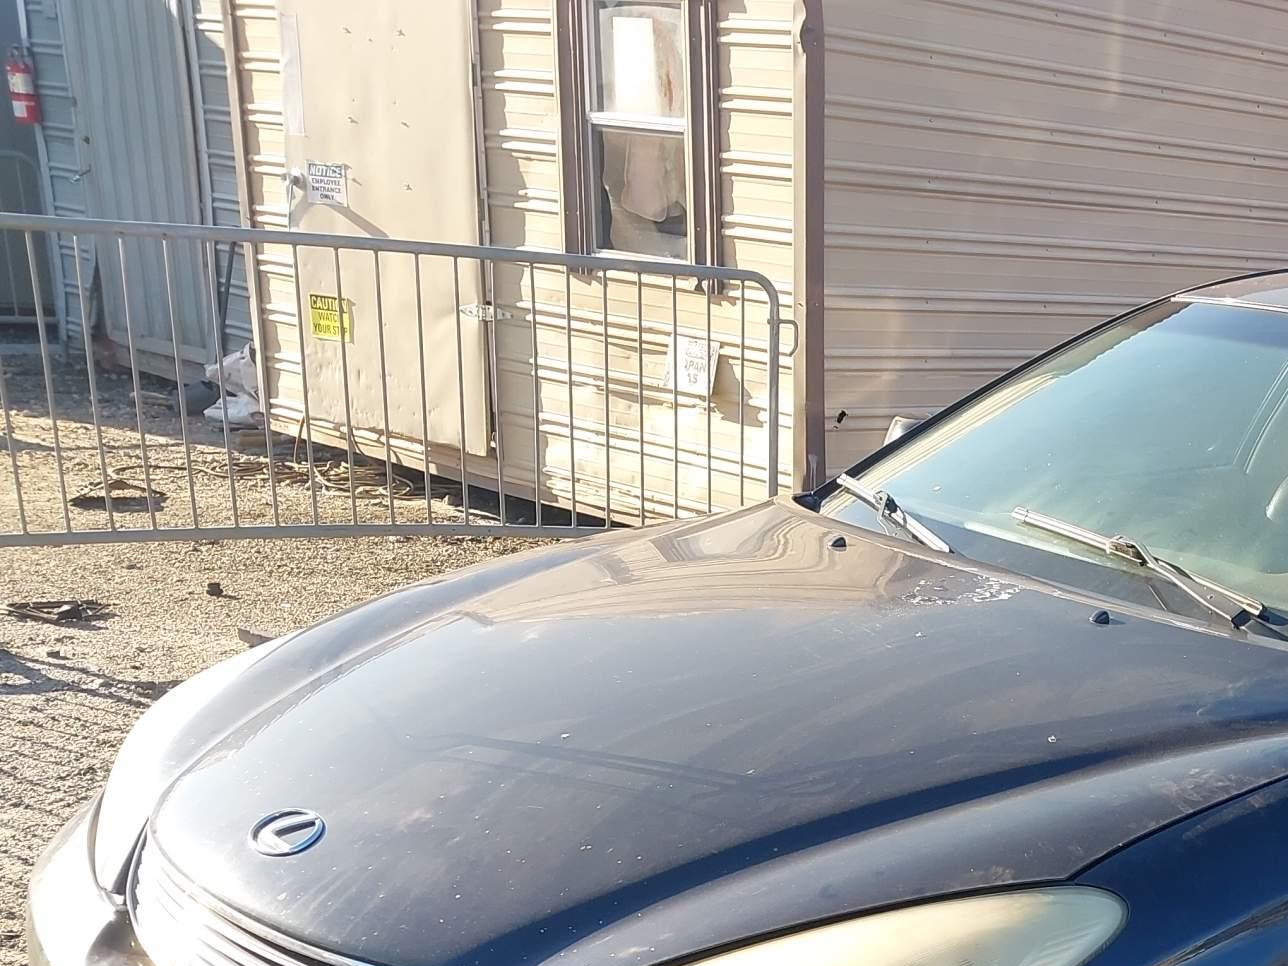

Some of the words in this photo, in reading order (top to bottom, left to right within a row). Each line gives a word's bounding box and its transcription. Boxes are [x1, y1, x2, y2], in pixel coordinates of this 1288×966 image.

[309, 165, 342, 177] NOTICE
[312, 178, 341, 186] EMPLOYEE
[311, 185, 341, 193] ENTRANCE
[311, 296, 347, 312] CAUTIN
[319, 311, 340, 323] WATC
[313, 323, 331, 334] YOUR
[332, 325, 348, 336] STP
